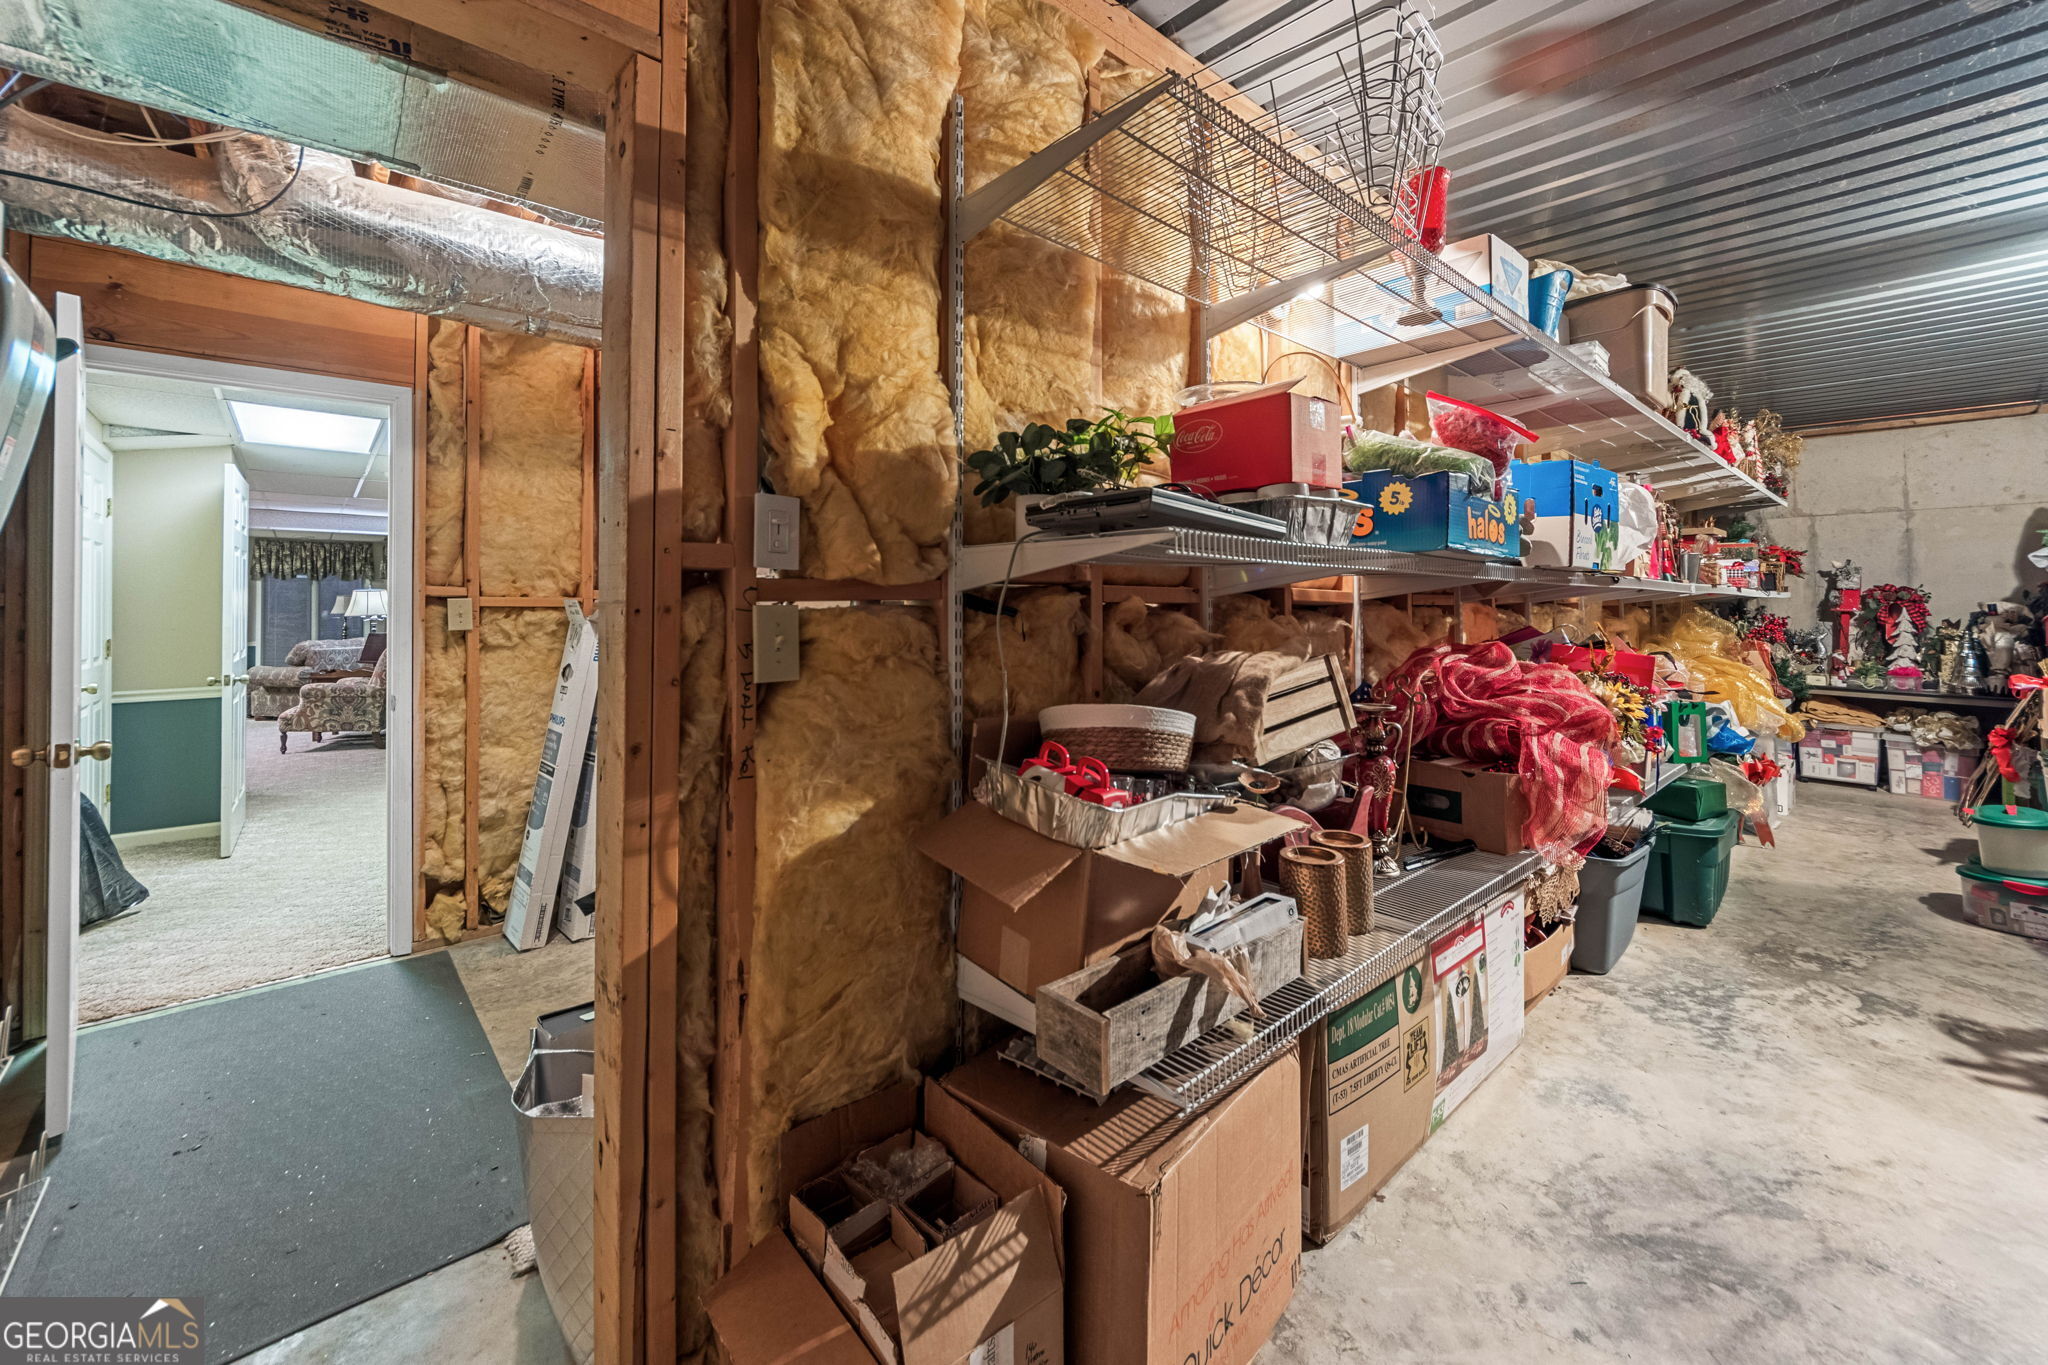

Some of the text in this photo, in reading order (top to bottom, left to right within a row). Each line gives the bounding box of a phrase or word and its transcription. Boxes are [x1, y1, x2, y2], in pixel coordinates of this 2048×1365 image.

[1467, 505, 1506, 545] halos
[1331, 1025, 1347, 1046] Dept.
[1409, 1024, 1423, 1041] TEAM
[1410, 1036, 1424, 1055] LIFT
[1331, 1037, 1391, 1080] CMAS ARTIFICIAL TREE
[1363, 1067, 1385, 1086] LIBERTY
[1169, 1250, 1231, 1344] Amazing
[1231, 1218, 1256, 1257] Has
